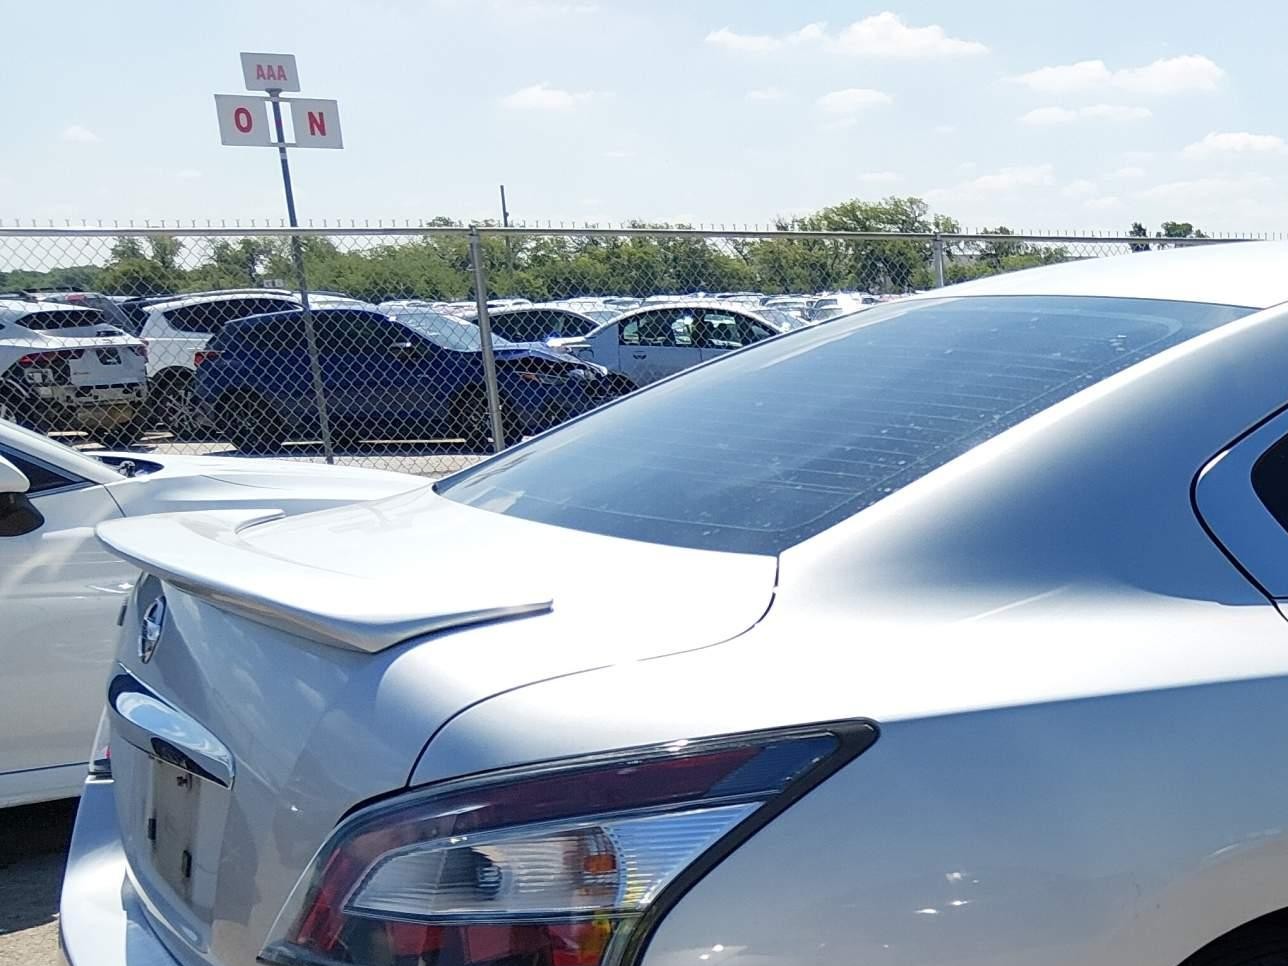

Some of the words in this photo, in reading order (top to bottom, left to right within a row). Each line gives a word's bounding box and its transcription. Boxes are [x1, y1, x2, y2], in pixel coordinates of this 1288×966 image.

[256, 64, 288, 81] AAA
[234, 107, 253, 133] O
[307, 111, 327, 136] N
